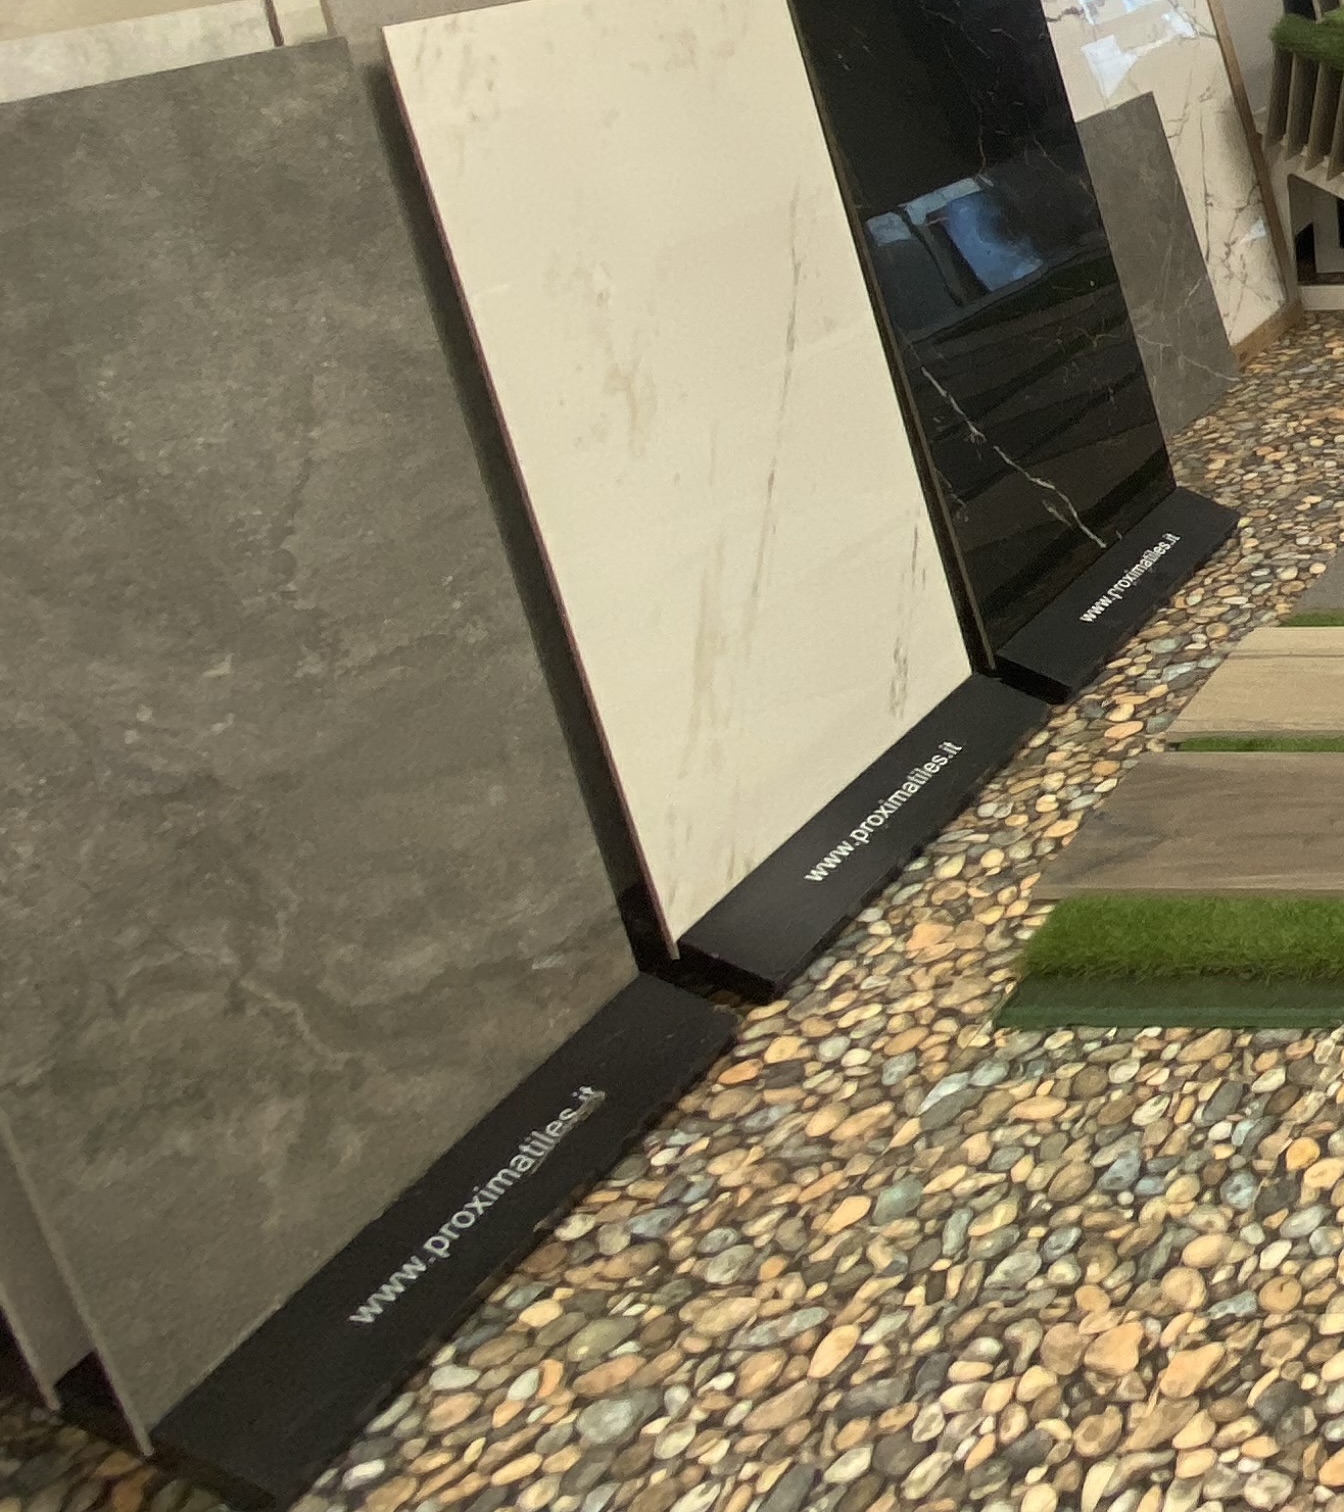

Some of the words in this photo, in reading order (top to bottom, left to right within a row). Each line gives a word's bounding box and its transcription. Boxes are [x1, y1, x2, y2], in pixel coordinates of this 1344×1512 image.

[1079, 533, 1181, 623] www.proximatiles.it
[803, 741, 963, 881] www.proximatiles.it
[349, 1086, 598, 1323] www.proximatilesit
